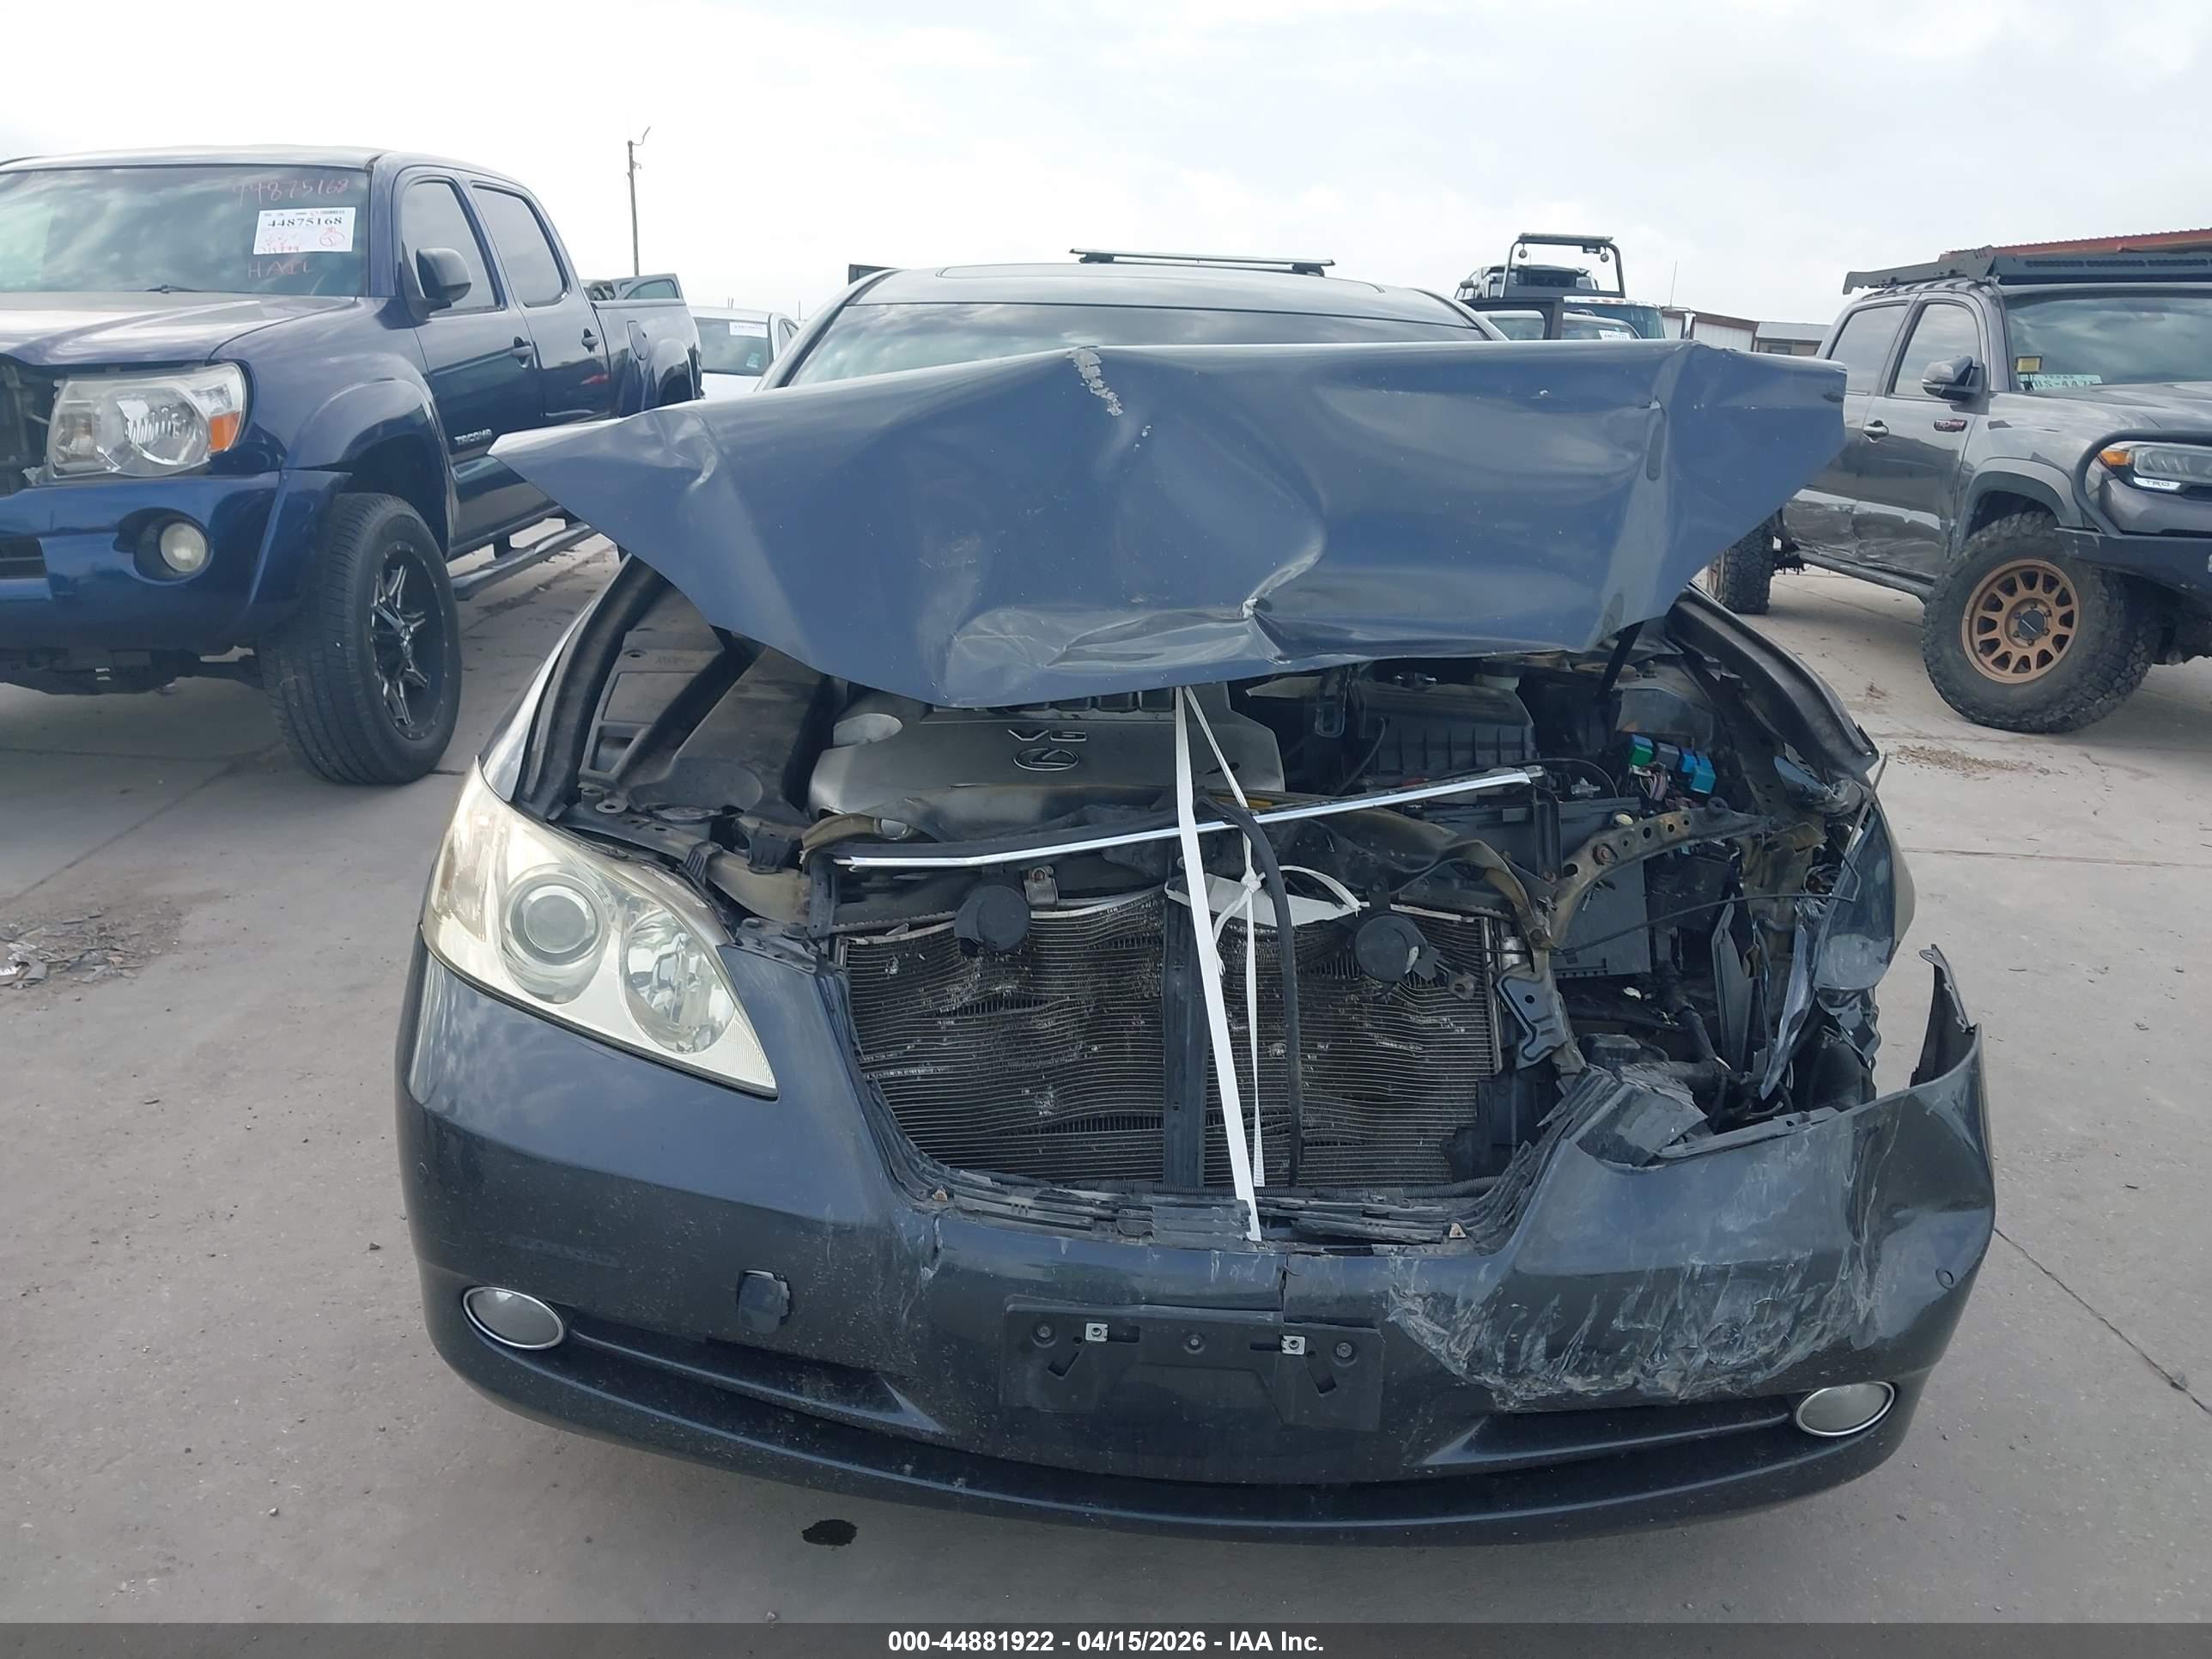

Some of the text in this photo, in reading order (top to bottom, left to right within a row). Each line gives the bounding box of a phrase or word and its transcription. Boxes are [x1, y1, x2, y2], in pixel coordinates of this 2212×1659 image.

[267, 216, 343, 227] 44875168
[247, 260, 313, 277] HAIL
[453, 428, 492, 446] TACOMA
[1007, 728, 1087, 742] V6
